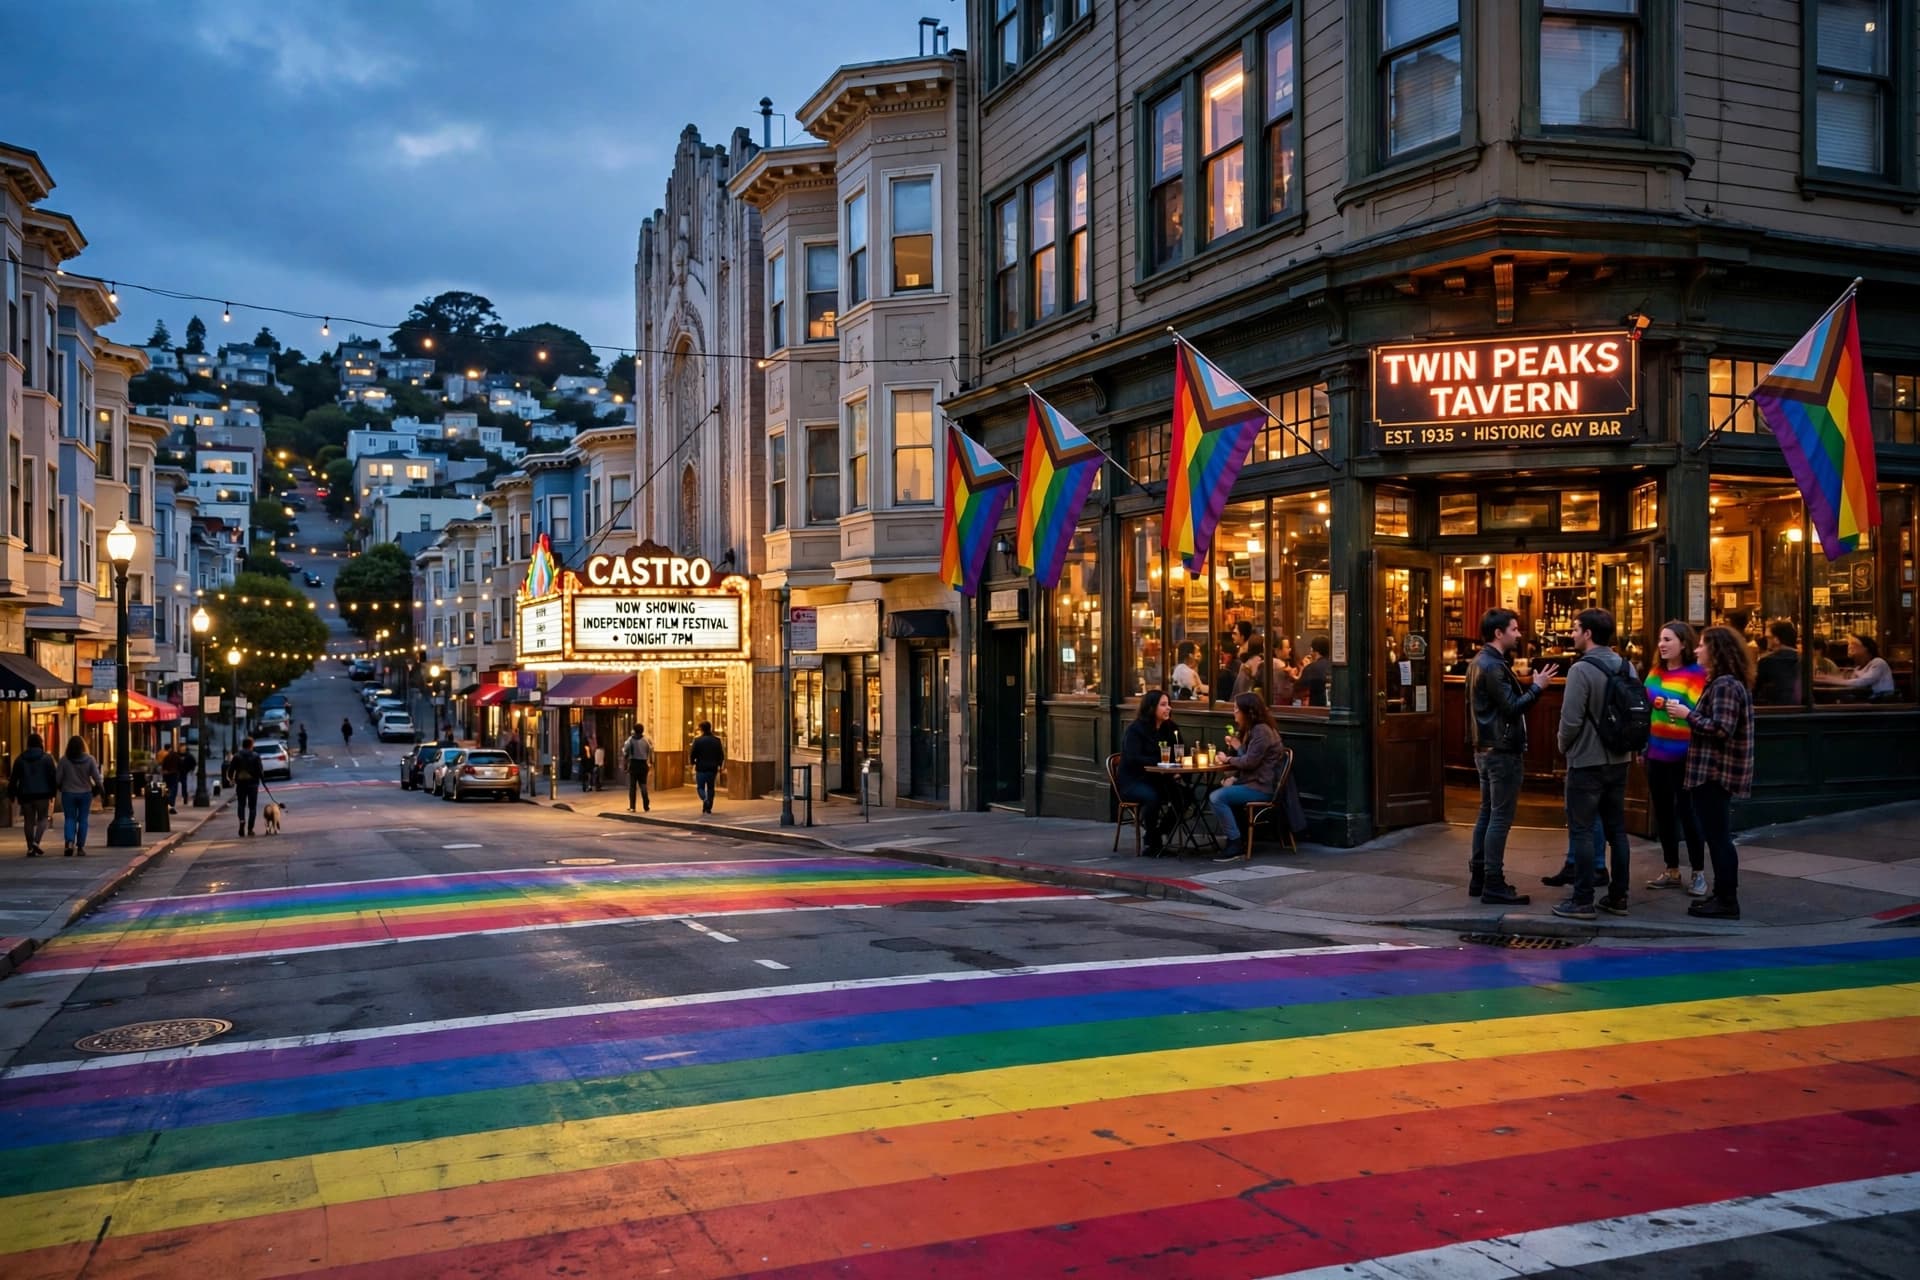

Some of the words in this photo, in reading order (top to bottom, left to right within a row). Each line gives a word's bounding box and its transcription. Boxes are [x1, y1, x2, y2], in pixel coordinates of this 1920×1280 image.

[1383, 350, 1477, 385] TWIN
[1493, 342, 1620, 378] PEAKS
[1430, 380, 1579, 417] TAVERN
[1385, 430, 1415, 444] EST.
[1420, 428, 1454, 443] 1935
[1474, 424, 1545, 440] HISTORIC
[1551, 422, 1582, 438] GAY
[1589, 420, 1621, 436] BAR
[588, 556, 711, 586] CASTRO
[615, 601, 640, 614] NOW
[646, 601, 695, 614] SHOWING
[583, 617, 652, 629] INDEPENDENT
[656, 617, 679, 629] FILM
[683, 617, 729, 630] FESTIVAL
[624, 632, 668, 645] TONIGHT
[671, 632, 693, 645] 7PM
